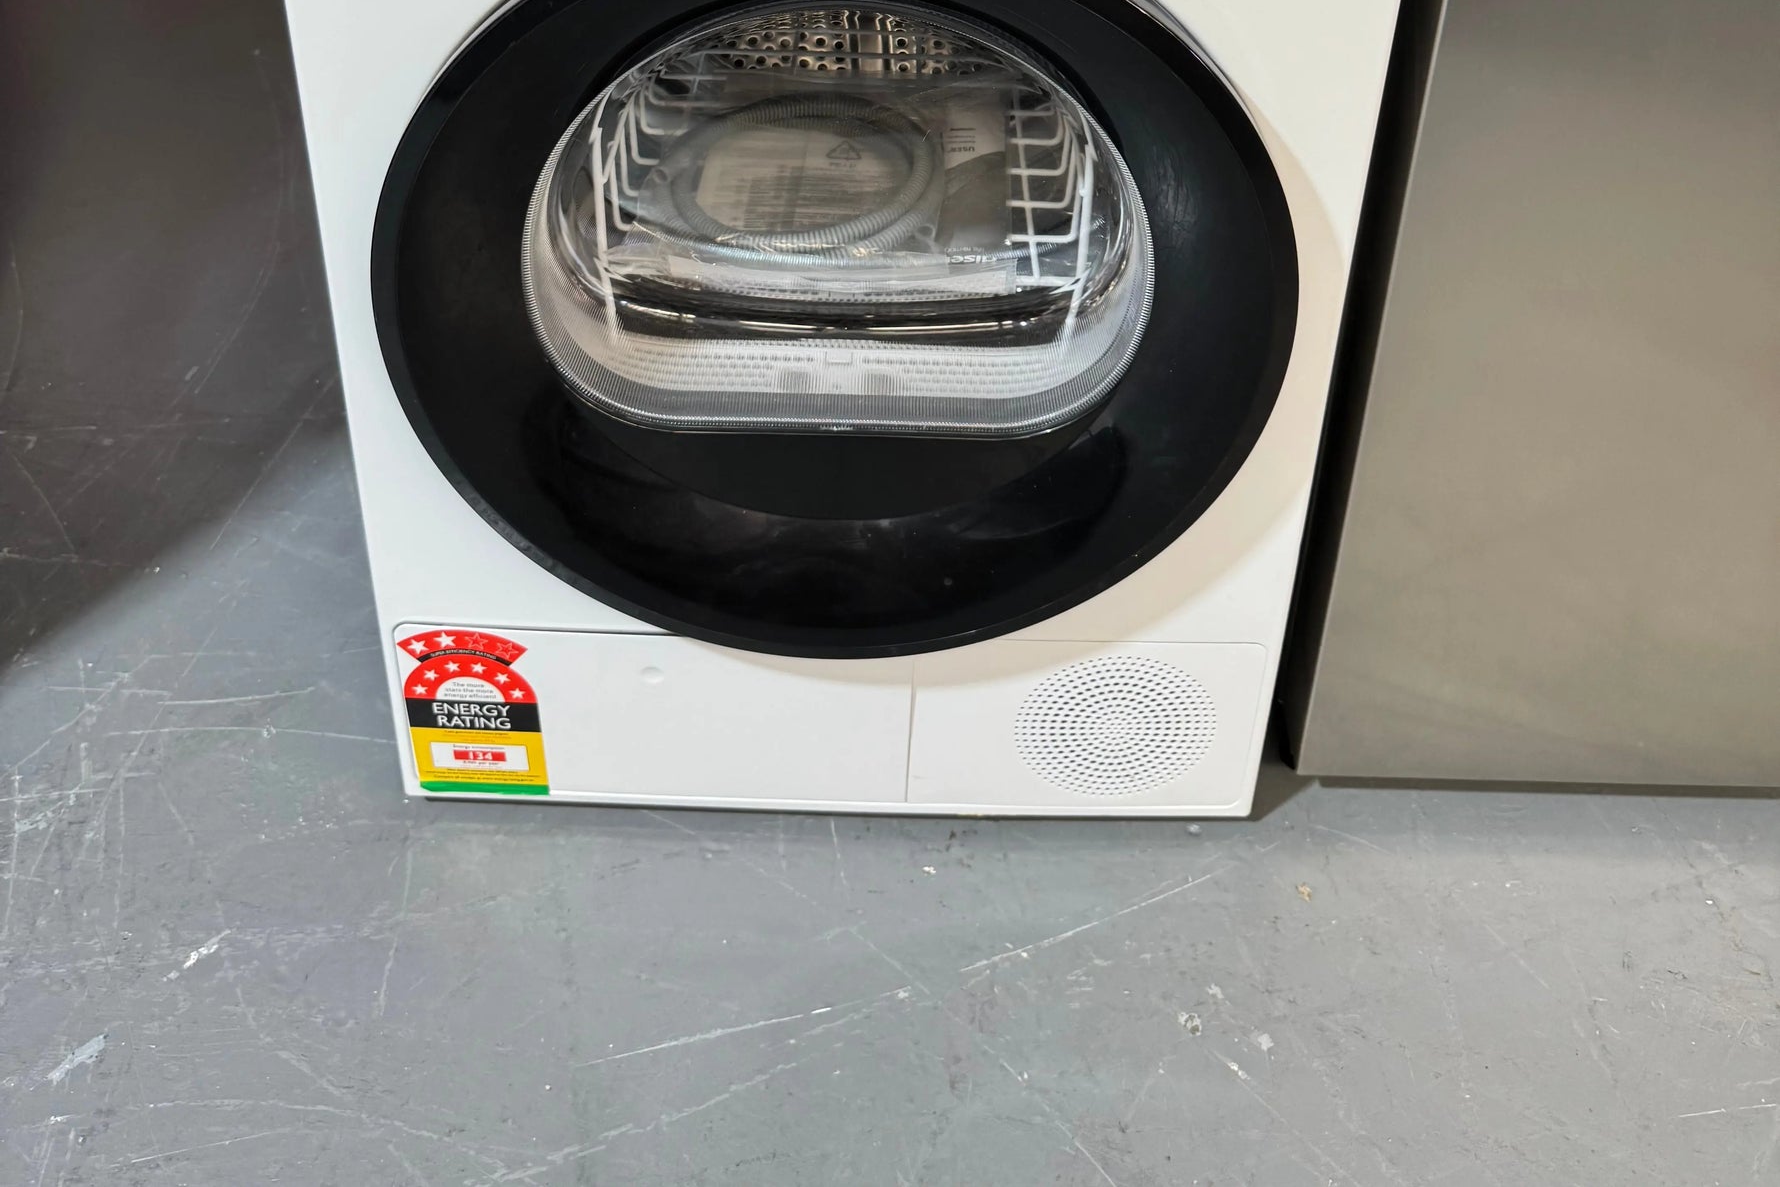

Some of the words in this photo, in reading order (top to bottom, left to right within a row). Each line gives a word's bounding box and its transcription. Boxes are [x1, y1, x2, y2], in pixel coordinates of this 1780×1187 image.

[432, 702, 511, 717] ENERGY
[437, 716, 511, 729] RATING
[469, 752, 493, 760] 134
